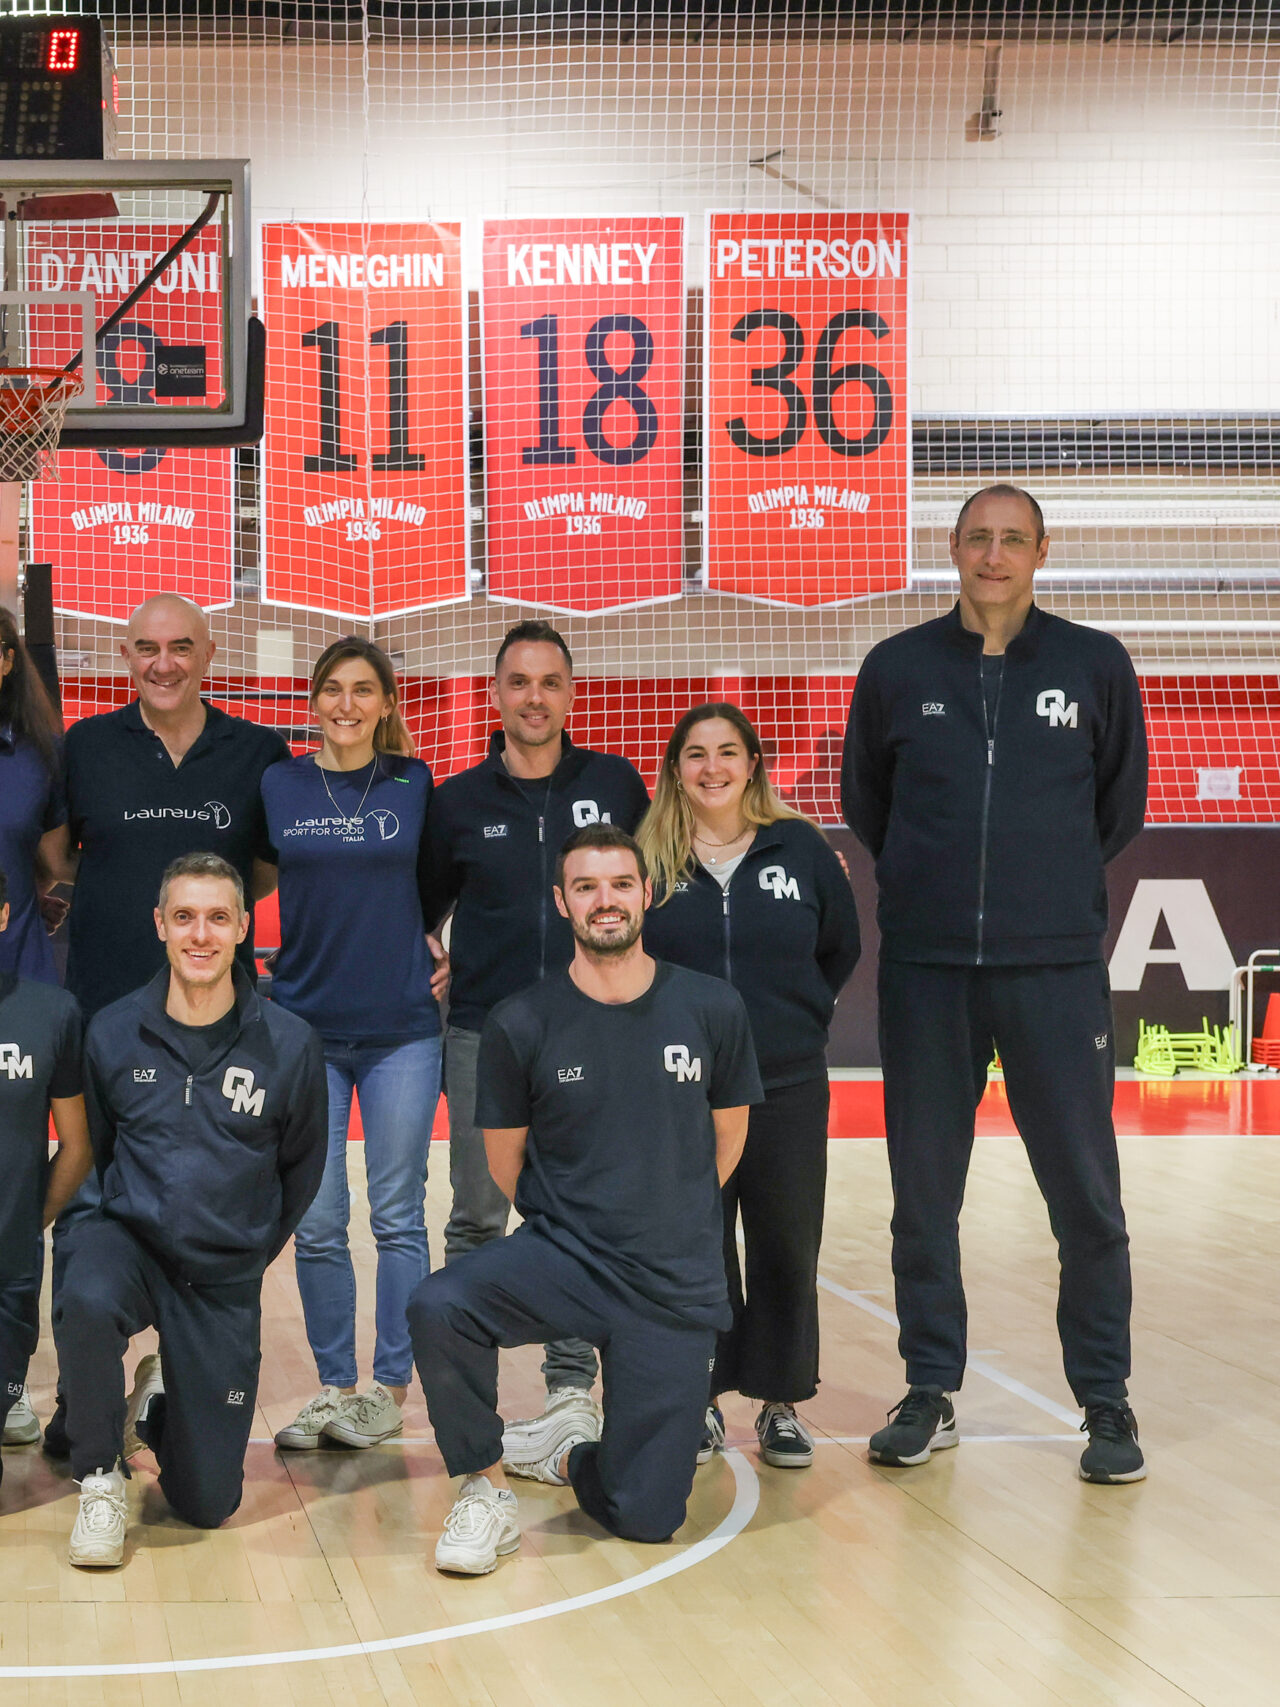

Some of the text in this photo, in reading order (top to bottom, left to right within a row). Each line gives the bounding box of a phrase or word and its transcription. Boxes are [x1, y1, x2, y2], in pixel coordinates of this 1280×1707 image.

[48, 31, 78, 69] 0
[41, 251, 217, 294] D'ANTONI
[282, 252, 444, 288] MENEGHIN
[507, 243, 658, 286] KENNEY
[716, 239, 901, 278] PETERSON
[301, 320, 426, 472] 11
[520, 313, 658, 466] 18
[724, 307, 894, 457] 36
[303, 498, 427, 527] OLIMPIA MILANO
[523, 492, 647, 521] OLIMPIA MILANO
[747, 485, 871, 514] OLIMPIA MILANO
[70, 501, 195, 531] OLIMPIA MILANO
[566, 515, 601, 535] 1936
[789, 508, 825, 528] 1936
[113, 525, 149, 545] 1936
[345, 521, 381, 541] 1936
[922, 703, 945, 713] EA7
[283, 826, 365, 837] SPORT FOR GOOD
[484, 825, 506, 837] EA7
[133, 1069, 156, 1079] EA7
[558, 1066, 583, 1079] EA7
[228, 1391, 245, 1401] EA7
